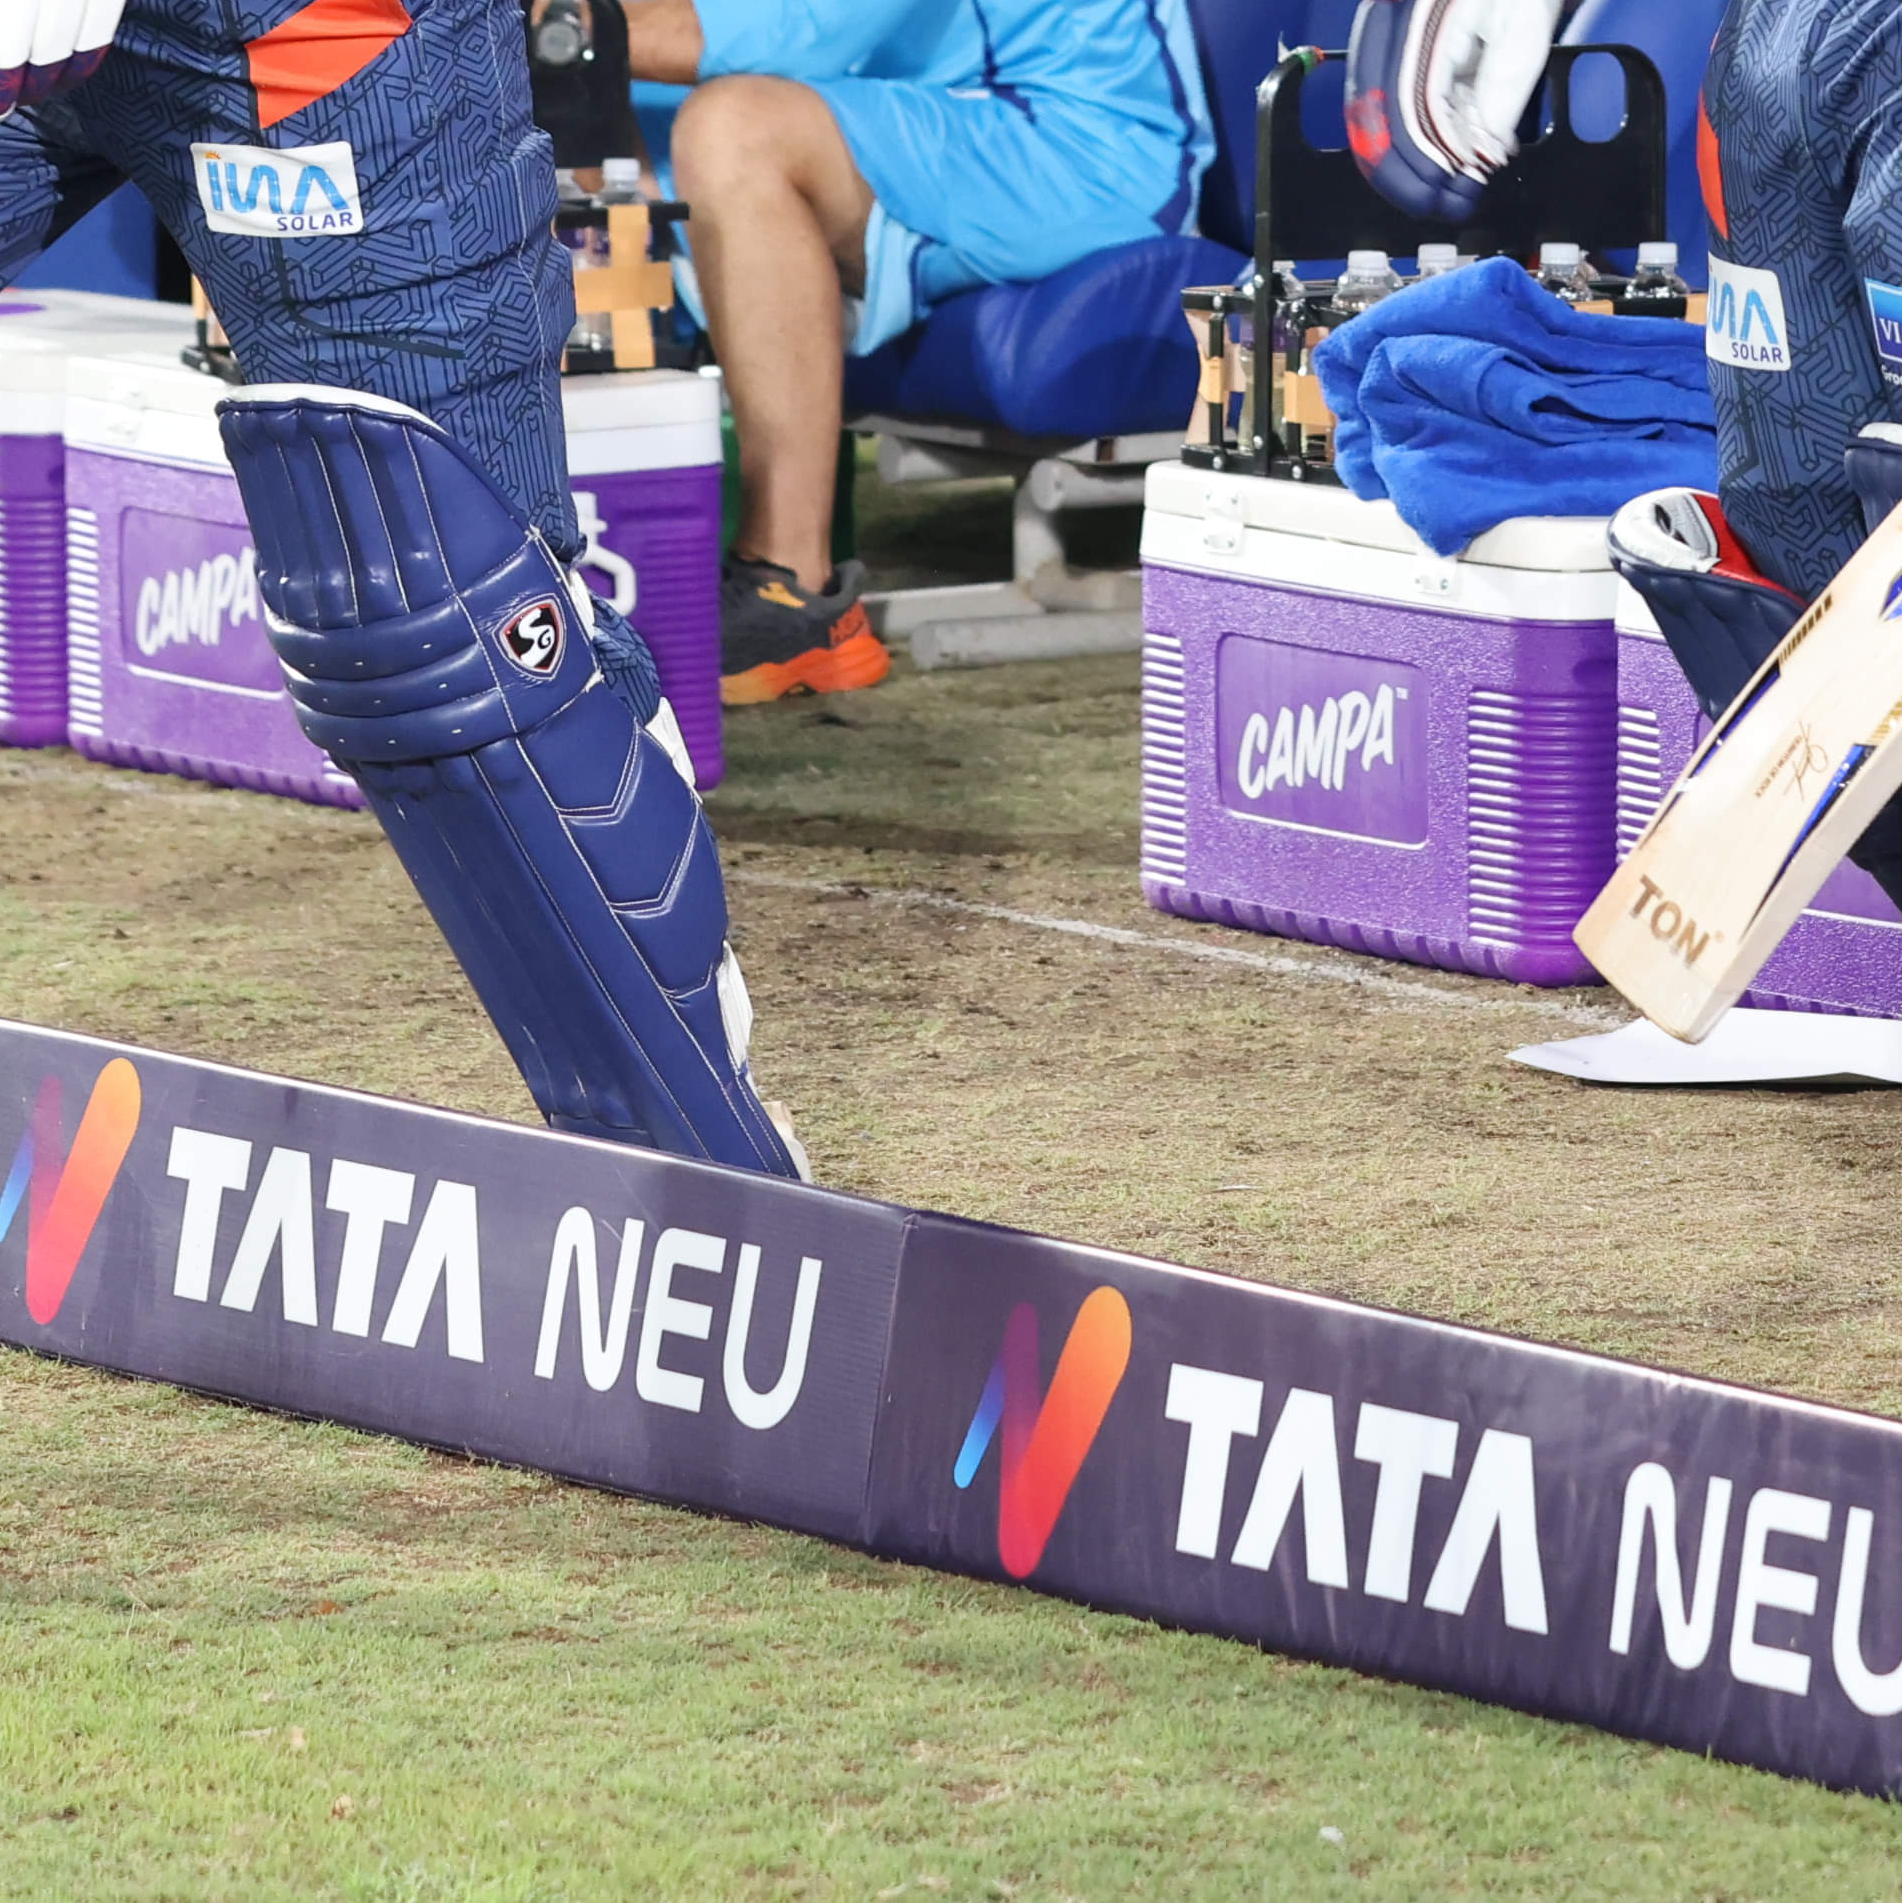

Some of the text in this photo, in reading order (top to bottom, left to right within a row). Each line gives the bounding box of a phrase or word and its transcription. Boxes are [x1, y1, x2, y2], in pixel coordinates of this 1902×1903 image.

[276, 212, 354, 232] SOLAR
[1731, 341, 1784, 364] SOLAR
[135, 545, 258, 657] CAMPA
[1236, 683, 1396, 800] CAMPA
[1629, 873, 1711, 970] TON
[166, 1127, 823, 1432] TATA NEU
[1164, 1362, 1550, 1637] TATA
